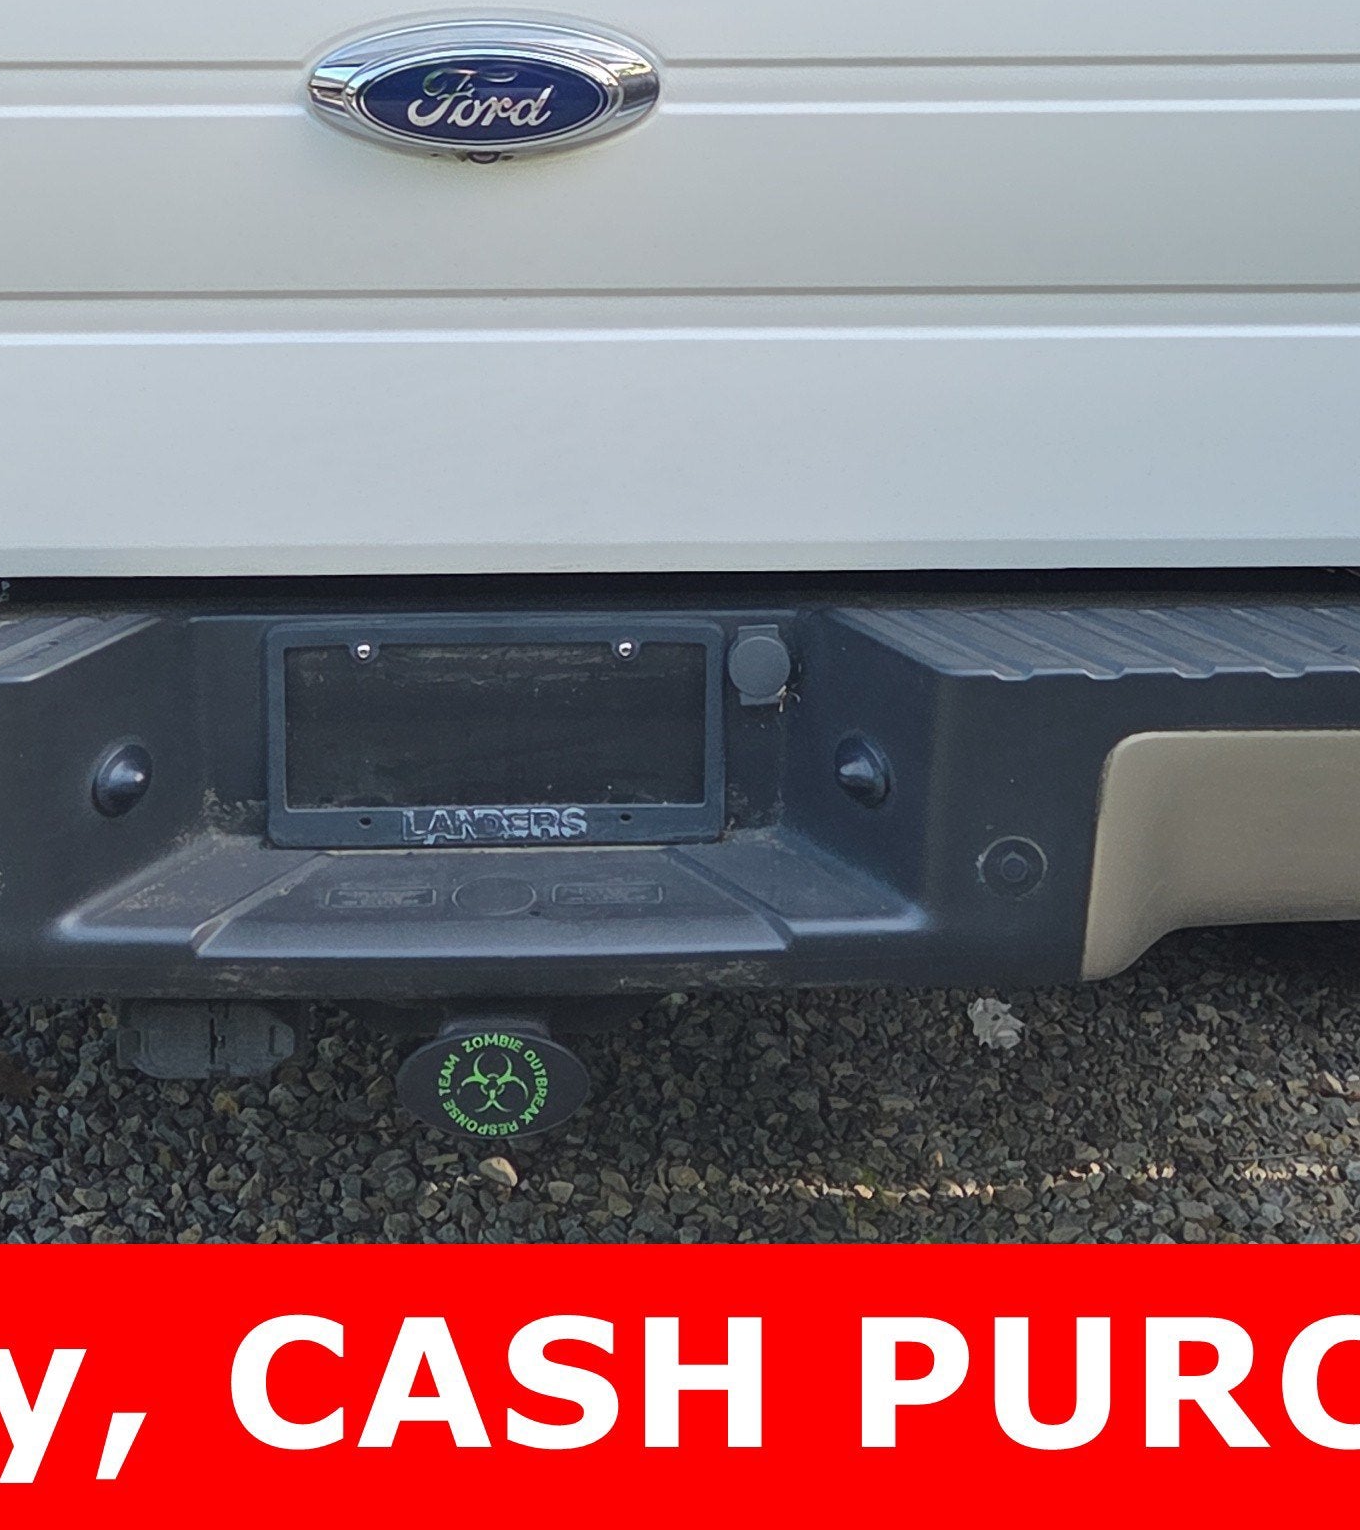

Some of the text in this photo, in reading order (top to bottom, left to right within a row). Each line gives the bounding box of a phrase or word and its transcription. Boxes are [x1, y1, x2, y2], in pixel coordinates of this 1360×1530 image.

[407, 69, 555, 128] Ford
[401, 806, 589, 845] LANDERS
[437, 1032, 549, 1136] ZOMBIE OUTBREAK RESPONSE TEAM
